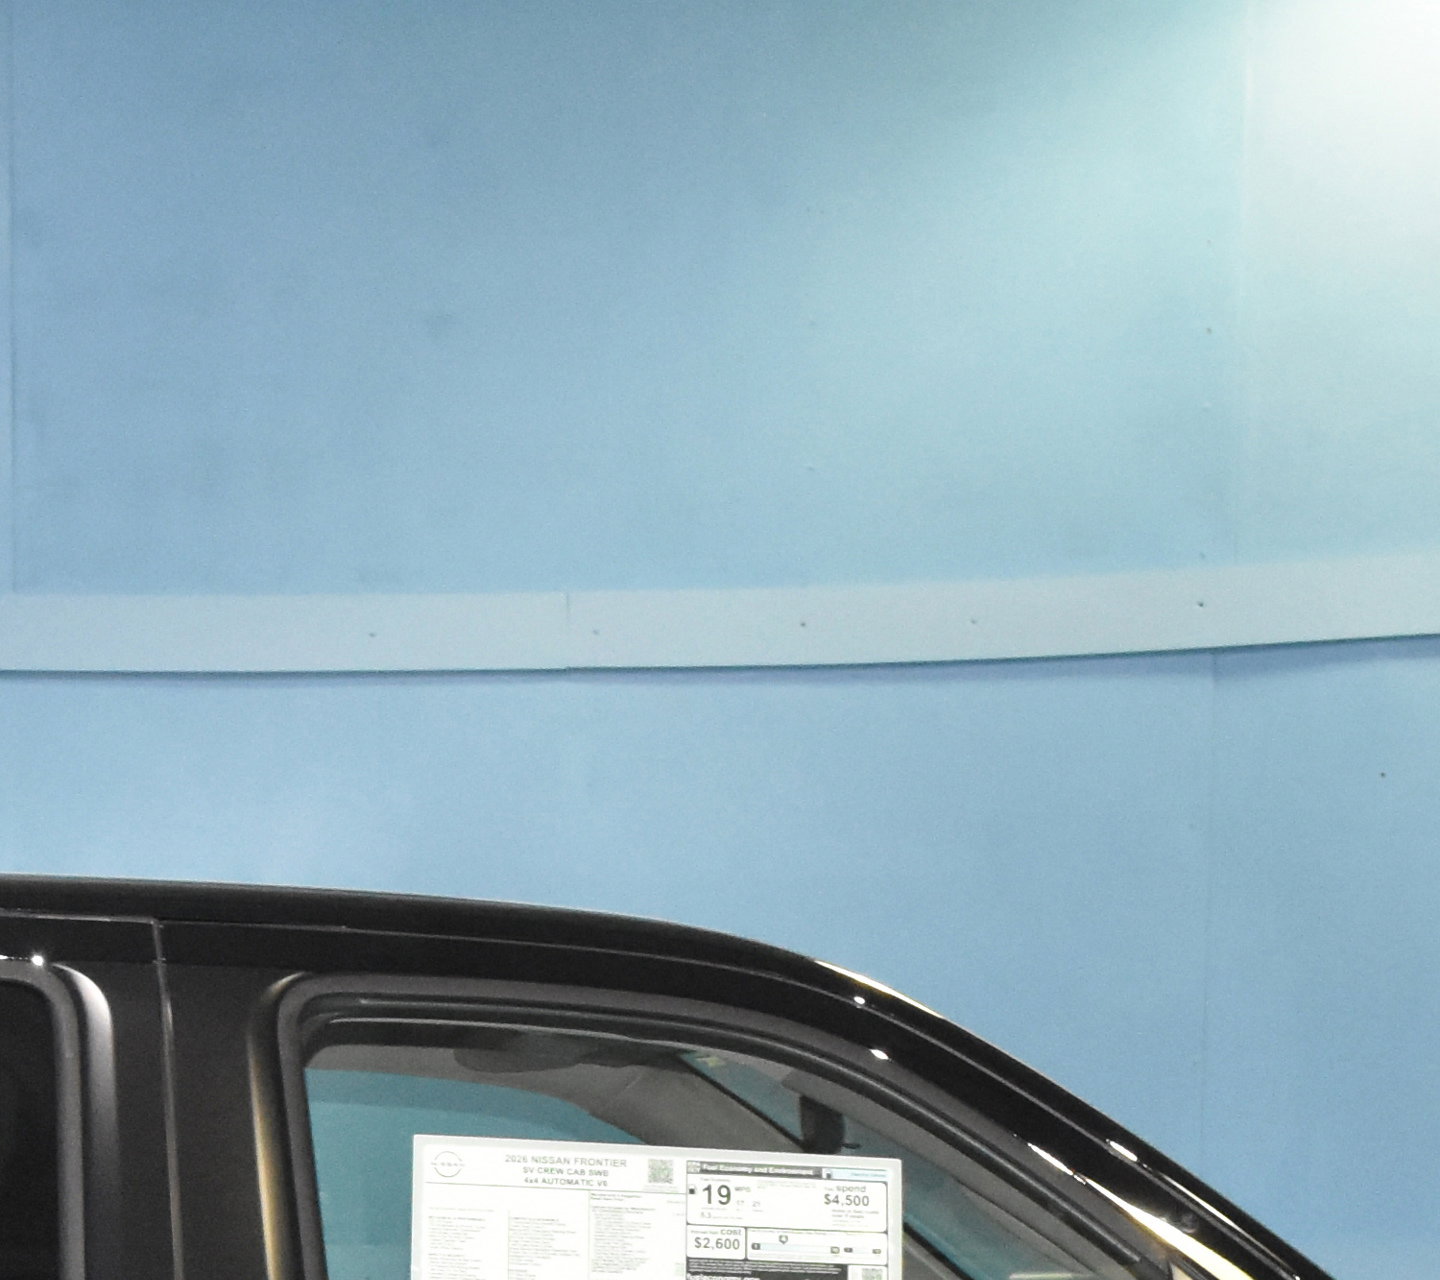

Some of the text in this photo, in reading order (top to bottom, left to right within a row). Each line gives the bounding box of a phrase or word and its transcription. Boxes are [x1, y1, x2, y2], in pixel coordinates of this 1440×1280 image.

[531, 1156, 570, 1165] NISSAN
[574, 1158, 627, 1168] FRONTIER
[523, 1166, 534, 1174] SV
[537, 1167, 564, 1175] CREW
[566, 1168, 586, 1176] CAB
[541, 1178, 594, 1187] AUTOMATIC
[702, 1184, 731, 1205] 19
[824, 1193, 869, 1207] $4,500
[694, 1236, 740, 1251] $2,600
